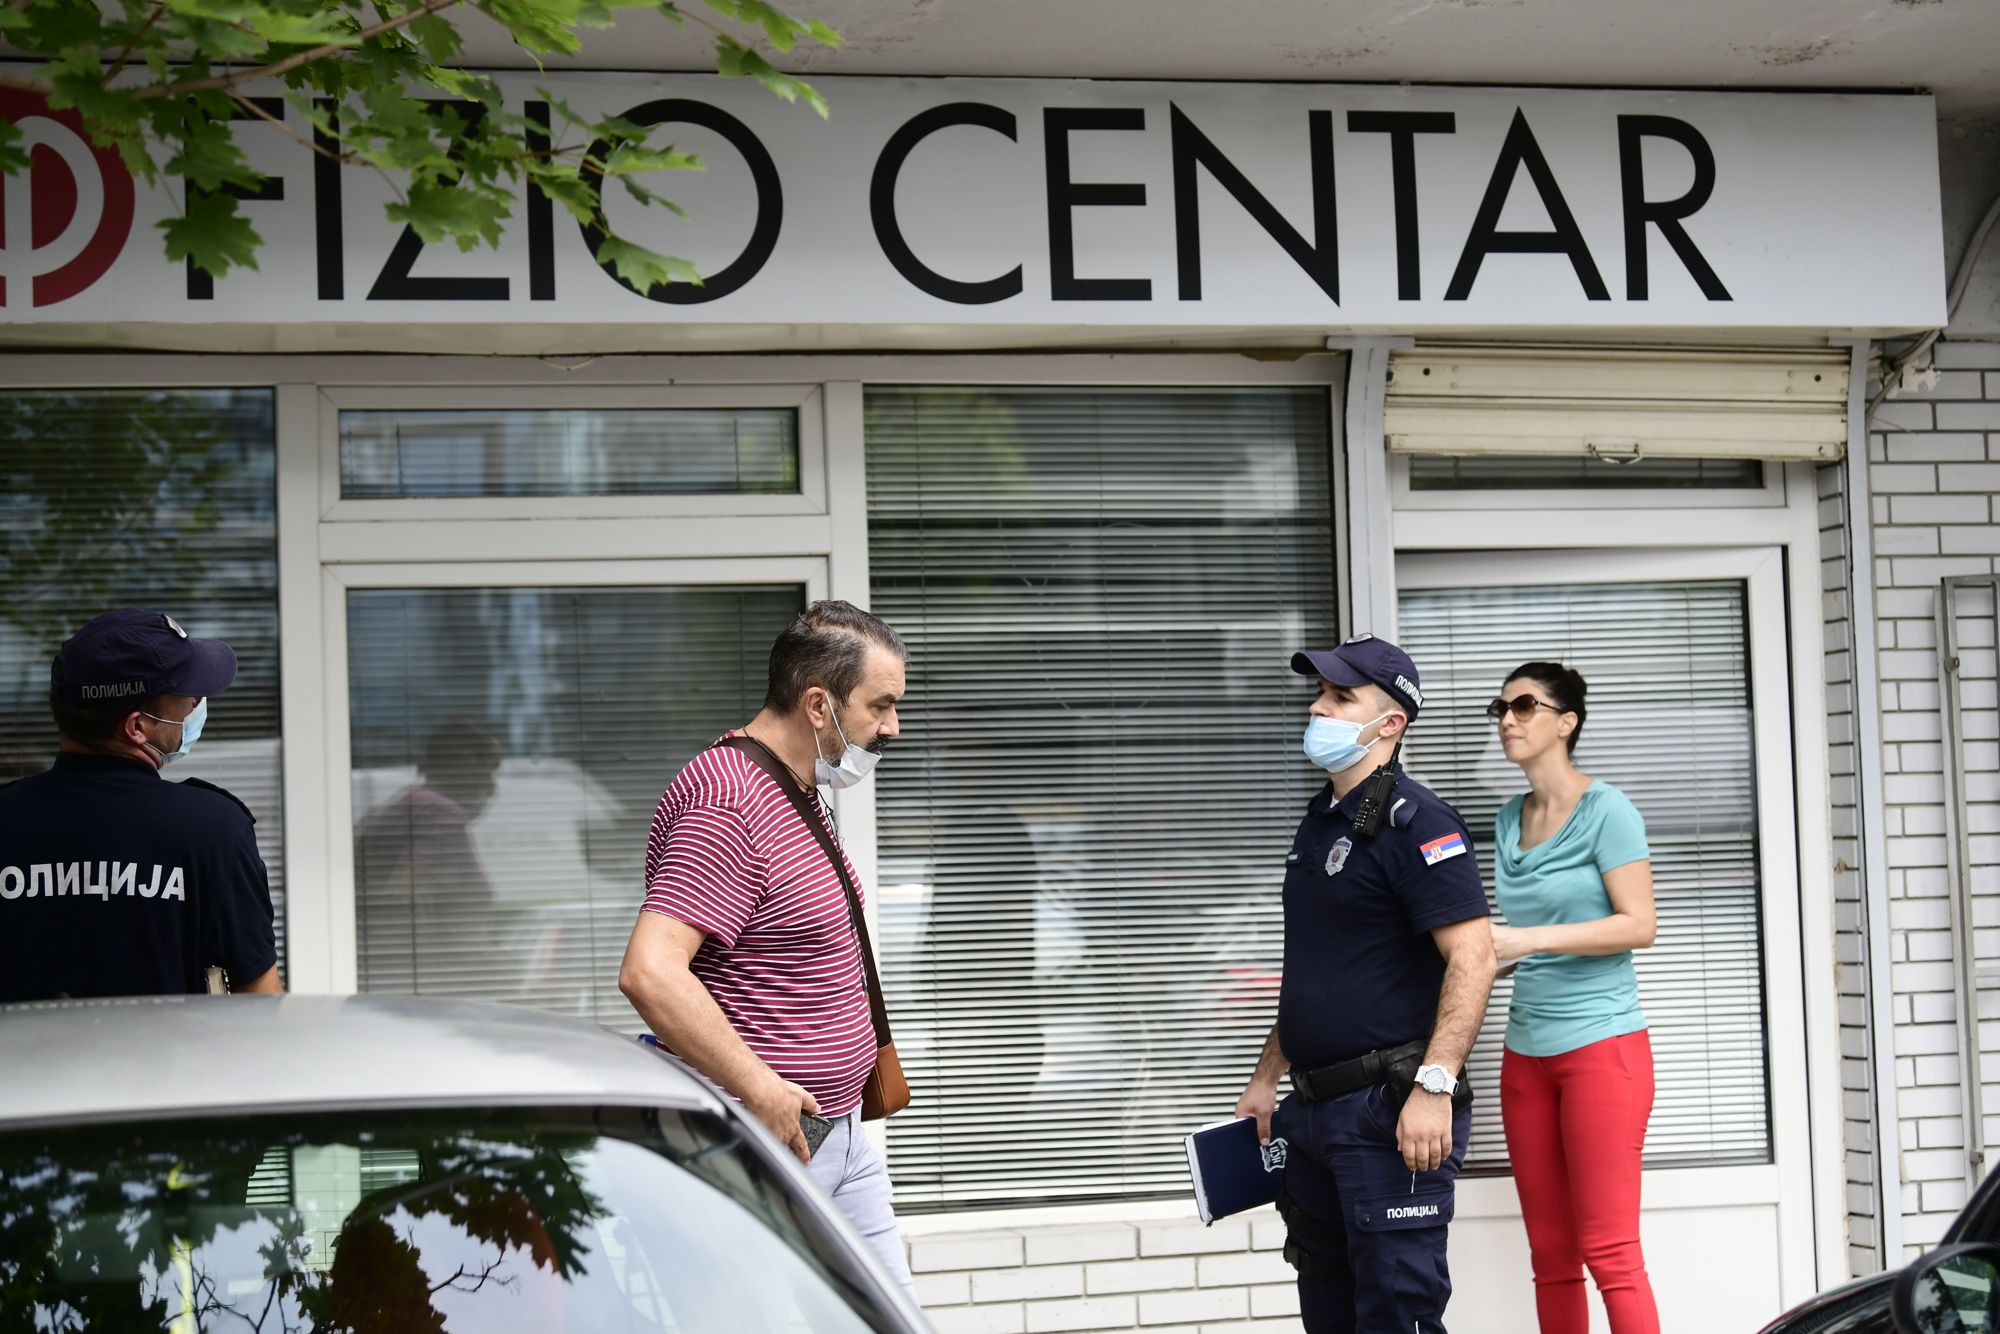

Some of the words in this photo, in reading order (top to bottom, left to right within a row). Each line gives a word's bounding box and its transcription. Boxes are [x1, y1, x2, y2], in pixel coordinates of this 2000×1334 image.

[869, 100, 1734, 307] CENTAR
[82, 680, 146, 699] ПОЛИЦИЈА
[1386, 1204, 1439, 1219] ПОЛИЦИЈА
